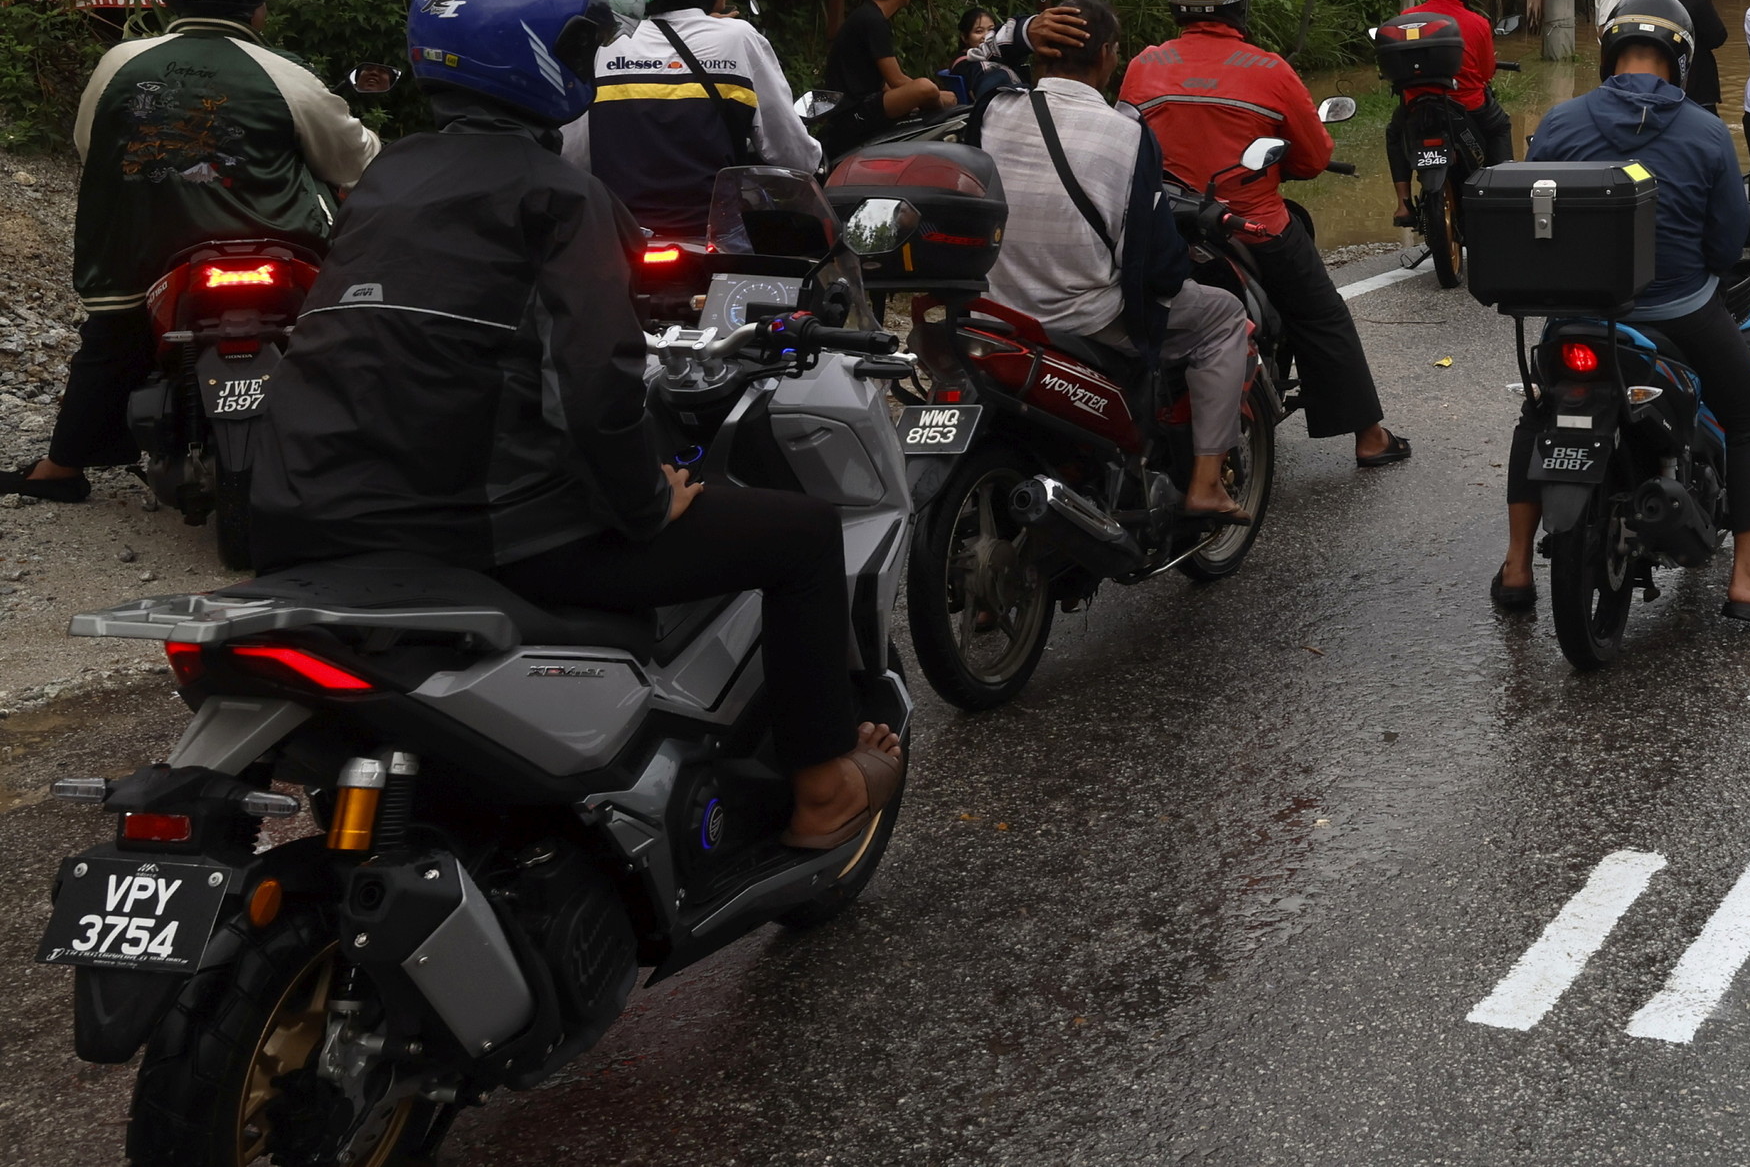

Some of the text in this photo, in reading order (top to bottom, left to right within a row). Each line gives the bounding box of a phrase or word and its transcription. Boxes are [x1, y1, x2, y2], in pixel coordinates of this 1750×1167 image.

[164, 61, 216, 79] Japan
[606, 56, 663, 70] ellesse
[1417, 156, 1447, 167] 2946
[1423, 150, 1442, 159] VAL
[352, 287, 374, 297] GIVI
[219, 378, 263, 398] JWE
[1040, 373, 1109, 413] MONSTER
[214, 394, 265, 414] 1597
[919, 409, 960, 427] WWQ
[906, 427, 957, 444] 8153
[1552, 447, 1589, 460] BSE
[1542, 458, 1594, 471] 8087
[105, 874, 183, 916] VPY
[72, 914, 180, 958] 3754
